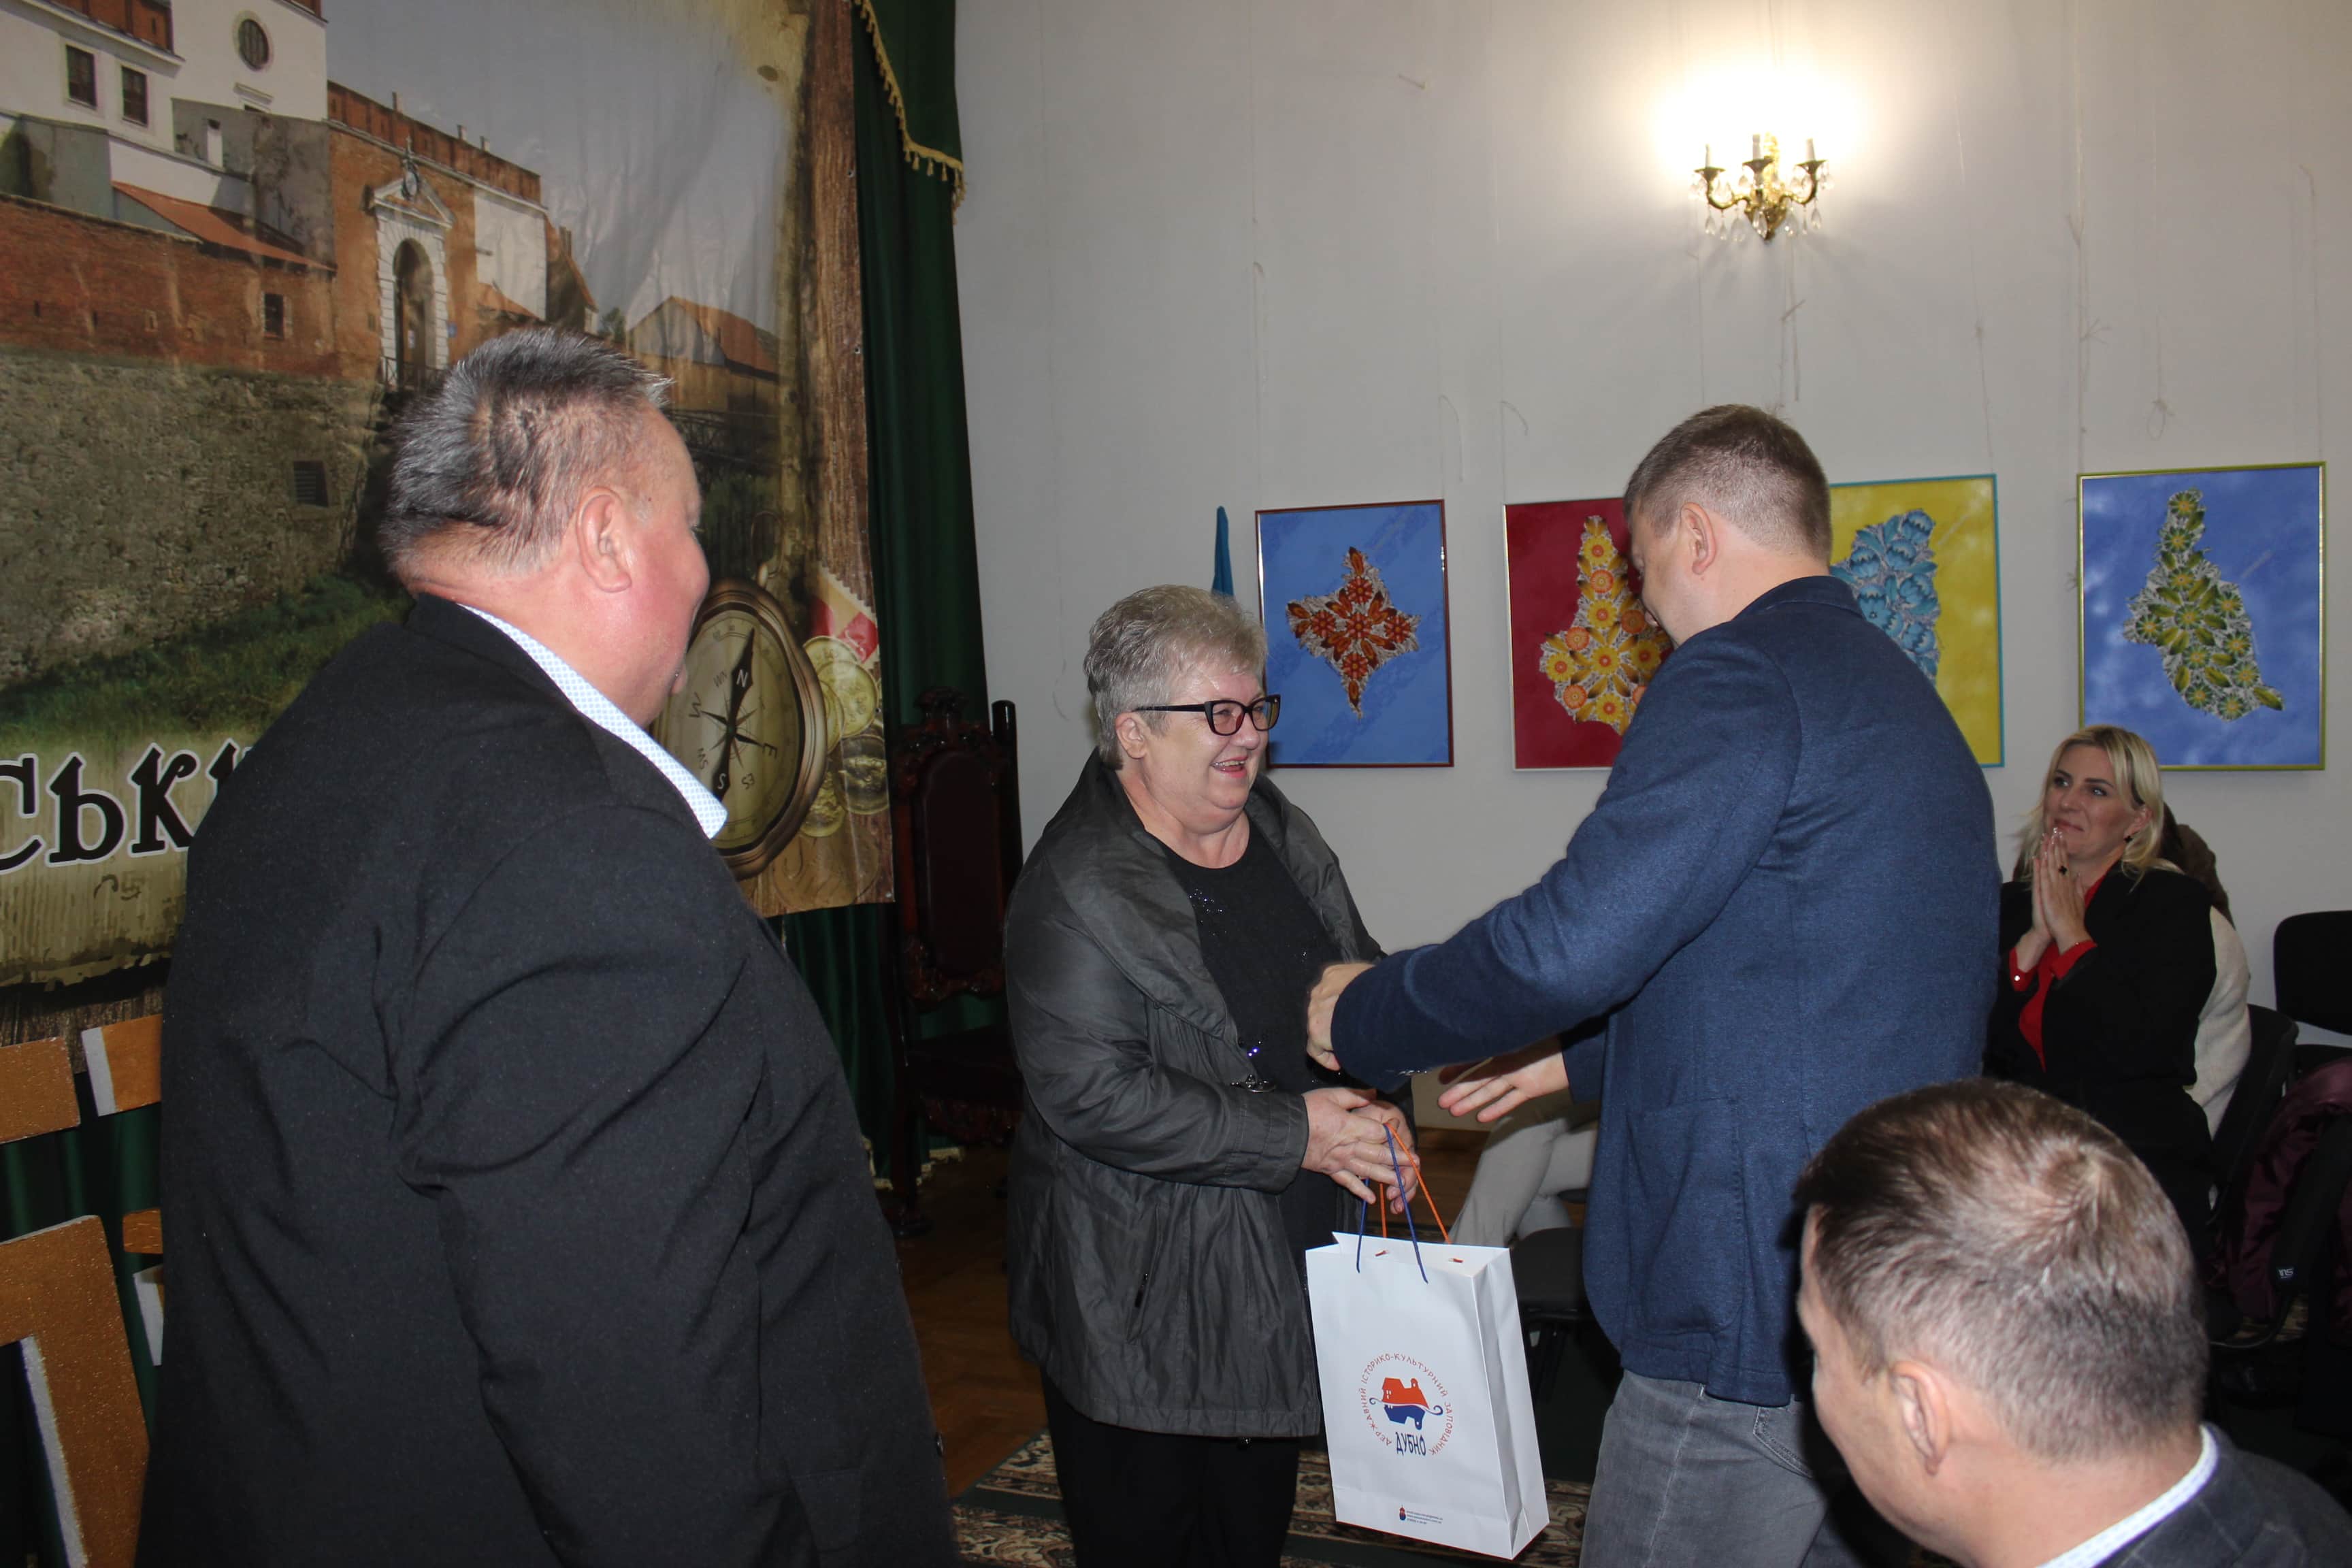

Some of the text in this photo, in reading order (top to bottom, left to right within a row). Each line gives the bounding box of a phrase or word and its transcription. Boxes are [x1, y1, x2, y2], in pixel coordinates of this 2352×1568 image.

[736, 669, 748, 687] N
[762, 742, 778, 759] E
[717, 773, 727, 789] S
[1358, 1353, 1454, 1456] ДЕРЖАВНИЙ ІСТОРИКО-КУЛЬТУРНИЙ ЗАПОВІДНИК
[1395, 1431, 1426, 1456] ДУБНО
